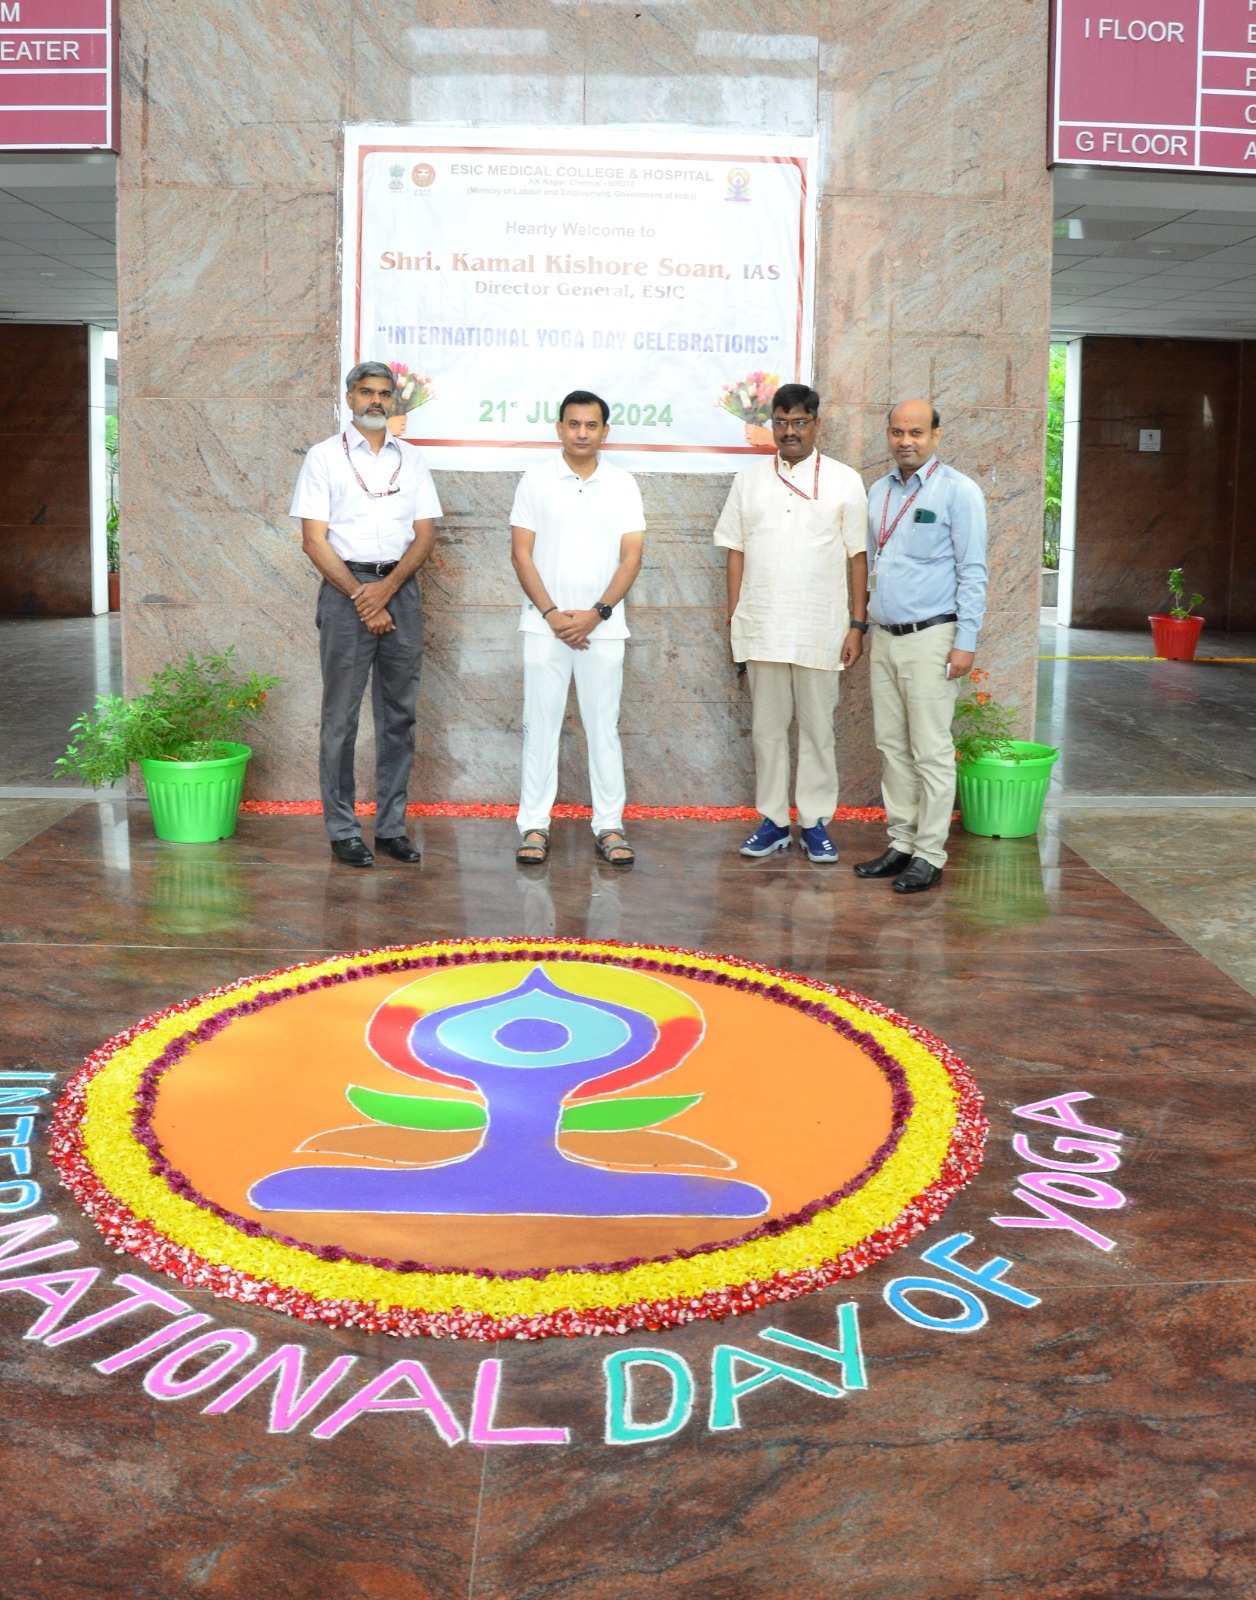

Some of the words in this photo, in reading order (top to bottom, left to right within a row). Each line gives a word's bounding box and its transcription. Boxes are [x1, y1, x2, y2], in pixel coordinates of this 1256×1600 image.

[1085, 18, 1090, 38] I
[1098, 18, 1185, 43] FLOOR
[0, 40, 80, 61] EATER
[1075, 131, 1095, 152] G
[1102, 132, 1188, 156] FLOOR
[450, 164, 484, 176] ESIC
[487, 165, 552, 178] MEDICAL
[556, 167, 625, 179] COLLEGE
[628, 168, 639, 179] &
[643, 169, 714, 182] HOSPITAL
[466, 186, 502, 196] (Ministry
[503, 187, 512, 195] of
[513, 187, 542, 196] Labour
[543, 188, 558, 196] and
[560, 188, 612, 199] Employment,
[614, 190, 663, 199] Government
[664, 191, 673, 199] of
[674, 192, 697, 201] India)
[505, 220, 557, 238] Hearty
[562, 222, 636, 238] Welcome
[640, 225, 656, 238] to
[379, 250, 441, 272] Shri.
[450, 252, 535, 274] Kamal
[545, 253, 649, 277] Kishore
[658, 257, 733, 280] Soan,
[742, 263, 781, 281] IAS
[474, 280, 551, 296] Director
[556, 282, 635, 299] General,
[642, 284, 685, 300] ESIC
[536, 328, 585, 349] YOGA
[592, 330, 626, 350] DAY
[526, 401, 561, 424] JU
[611, 402, 674, 427] 2024
[603, 1301, 868, 1445] DAY
[883, 1232, 1042, 1333] OF
[990, 1091, 1128, 1252] YOGA
